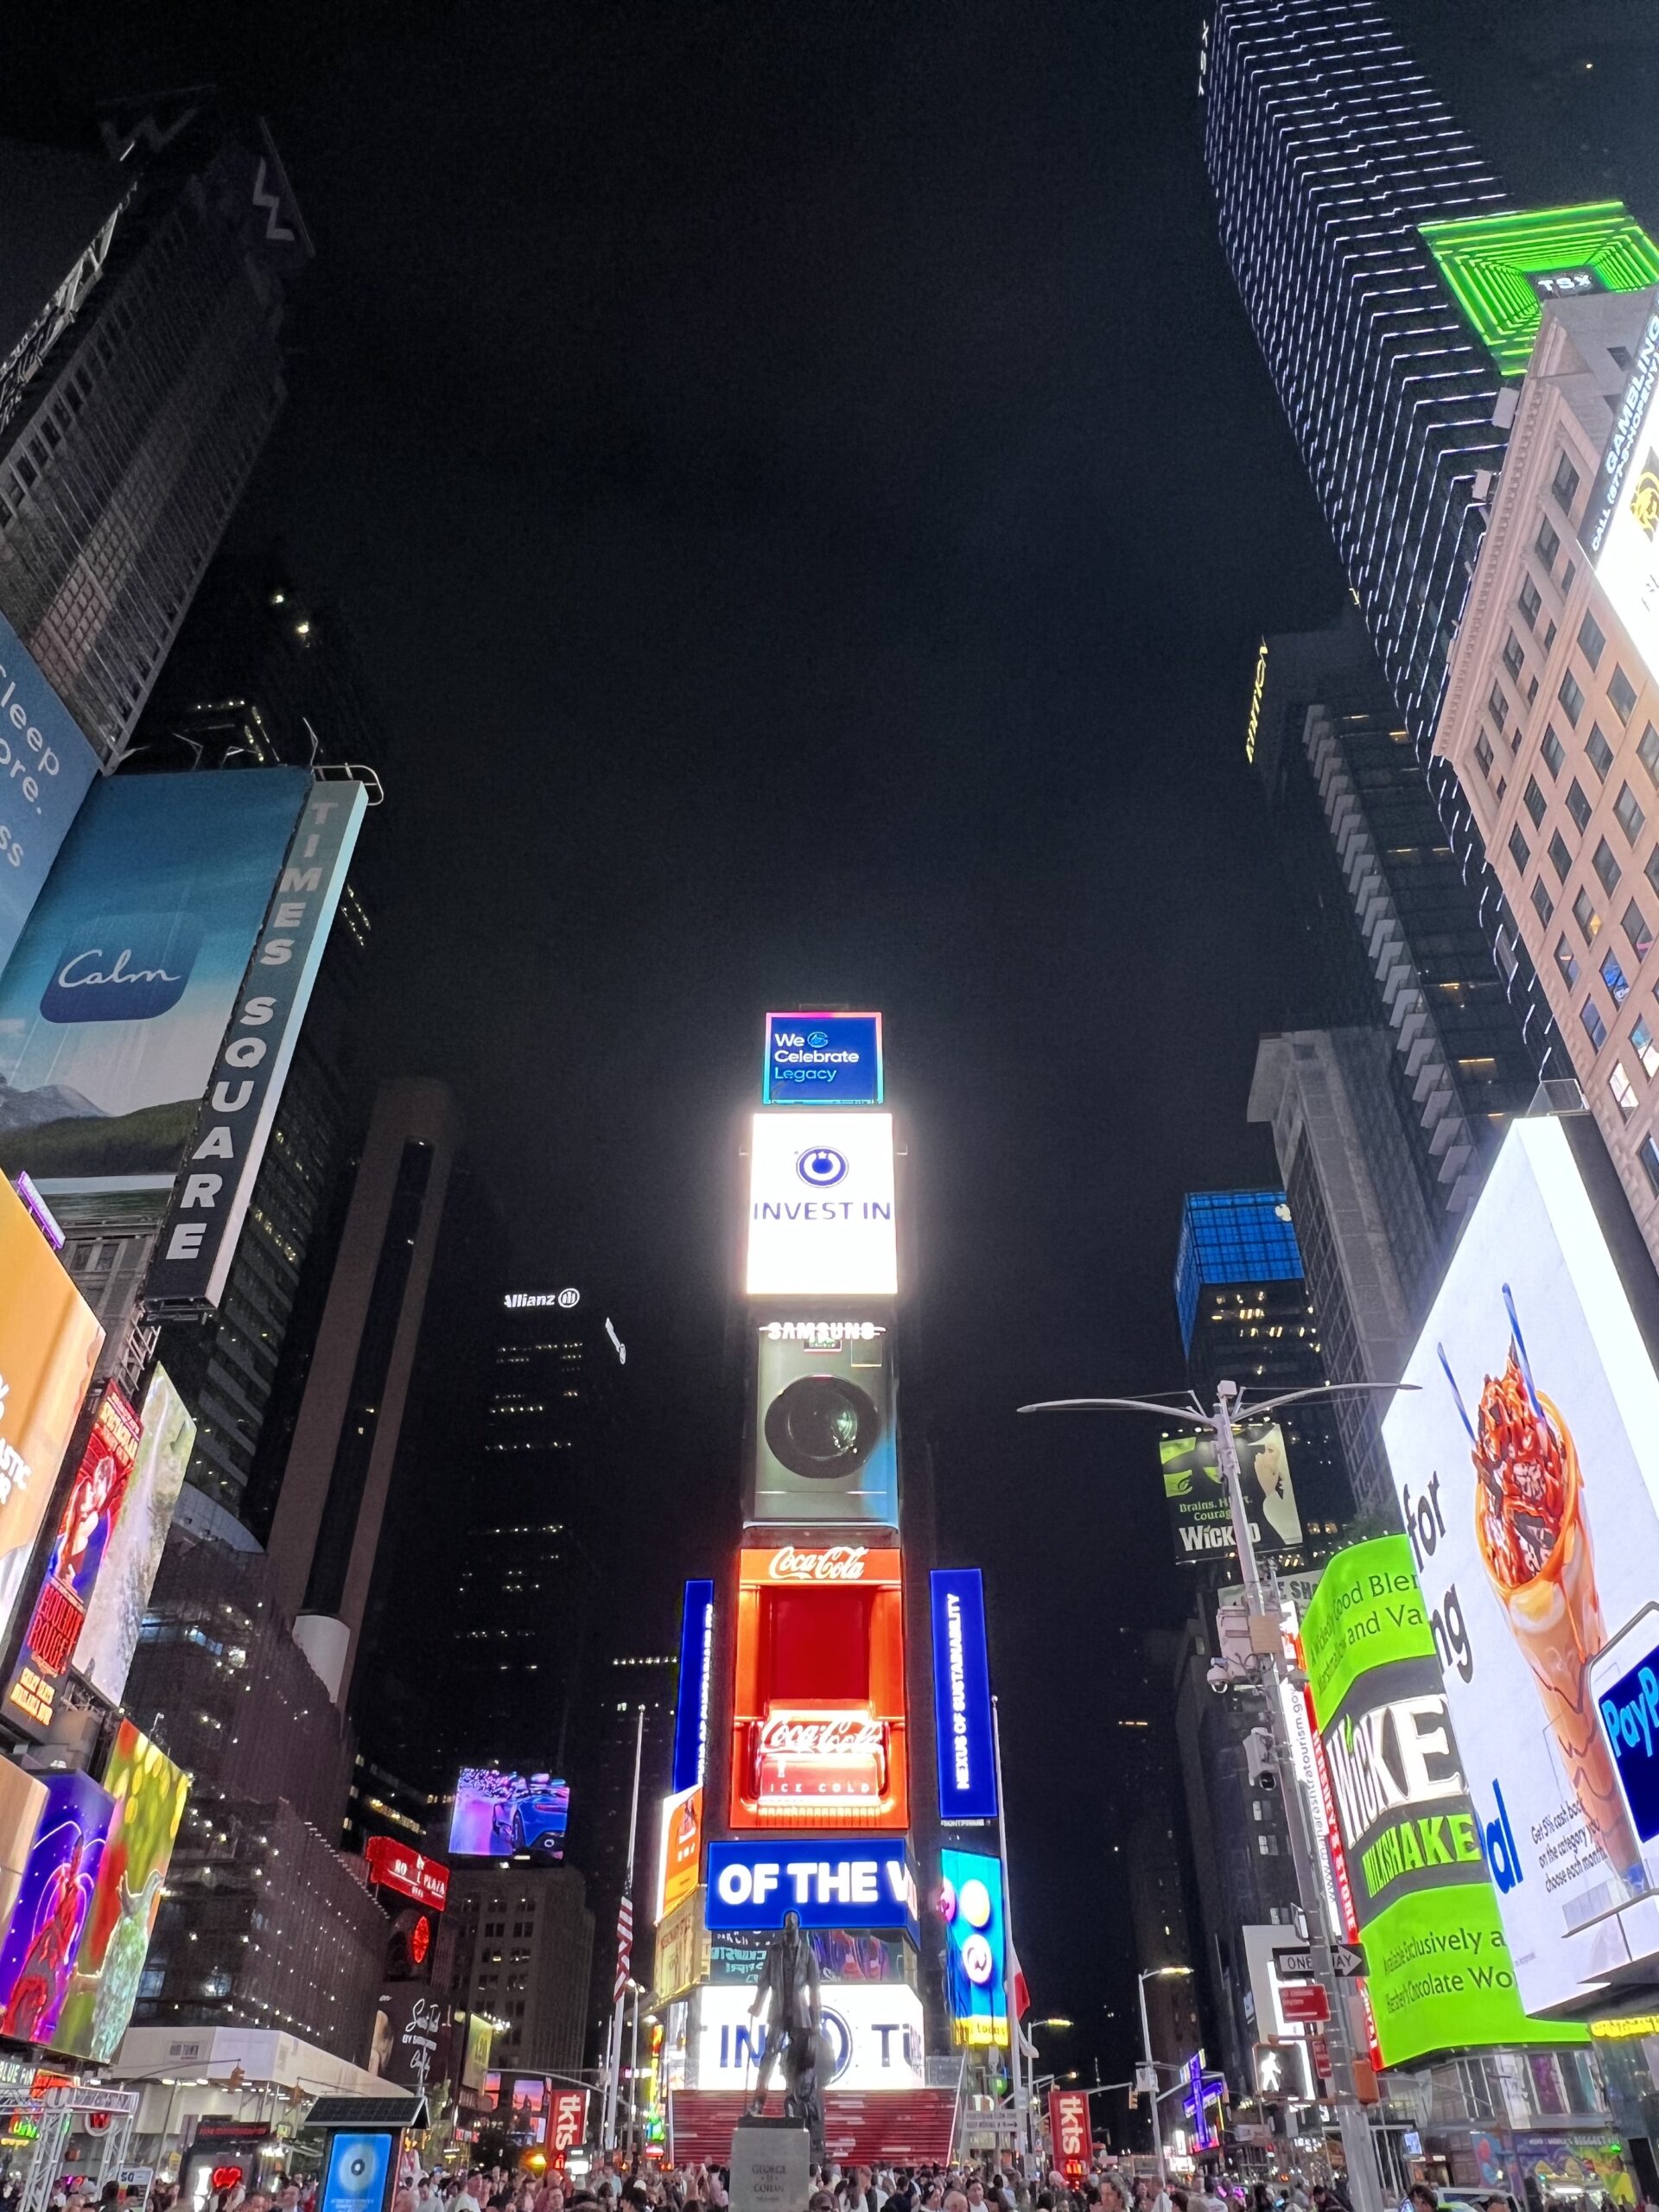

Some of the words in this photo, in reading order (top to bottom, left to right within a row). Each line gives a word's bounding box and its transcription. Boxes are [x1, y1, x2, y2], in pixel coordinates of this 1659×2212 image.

[1538, 274, 1592, 292] TSX
[1591, 508, 1611, 552] CALL
[0, 664, 60, 775] leep
[259, 802, 339, 966] TIMES
[59, 949, 181, 988] Calm
[774, 1033, 804, 1047] We
[774, 1050, 860, 1063] Celebrate
[774, 1067, 837, 1083] Legacy
[165, 997, 276, 1261] SQUARE
[753, 1202, 854, 1220] INVEST
[863, 1202, 891, 1220] IN
[504, 1294, 556, 1308] Allianz
[767, 1322, 875, 1340] SAMSUNG
[1179, 1498, 1217, 1513] Brains.
[1193, 1509, 1231, 1522] Courag
[768, 1546, 869, 1580] Coca-Cola
[1348, 1611, 1381, 1645] and
[947, 1593, 965, 1711] SUSTAINABILITY
[954, 1713, 966, 1735] OF
[955, 1737, 969, 1789] NEXUS
[771, 1783, 802, 1793] ICE
[818, 1783, 869, 1793] COLD
[1531, 1821, 1545, 1845] Get
[1553, 1802, 1568, 1829] cash
[1362, 1813, 1482, 1898] MILKSHAKE
[1546, 1843, 1559, 1862] the
[1557, 1825, 1588, 1859] category
[423, 1873, 446, 1895] PLAZA
[719, 1863, 779, 1904] OF
[787, 1861, 878, 1904] THE
[1545, 1867, 1567, 1894] choose
[1566, 1856, 1584, 1882] each
[1336, 1854, 1358, 1934] STORE
[1287, 1956, 1313, 1969] ONE
[1335, 1955, 1353, 1967] AY
[1403, 1927, 1483, 1962] Exclusively
[1408, 1972, 1465, 2004] Chocolate
[720, 2024, 767, 2069] IN
[555, 2094, 580, 2151] tkts
[1060, 2096, 1083, 2154] tkts
